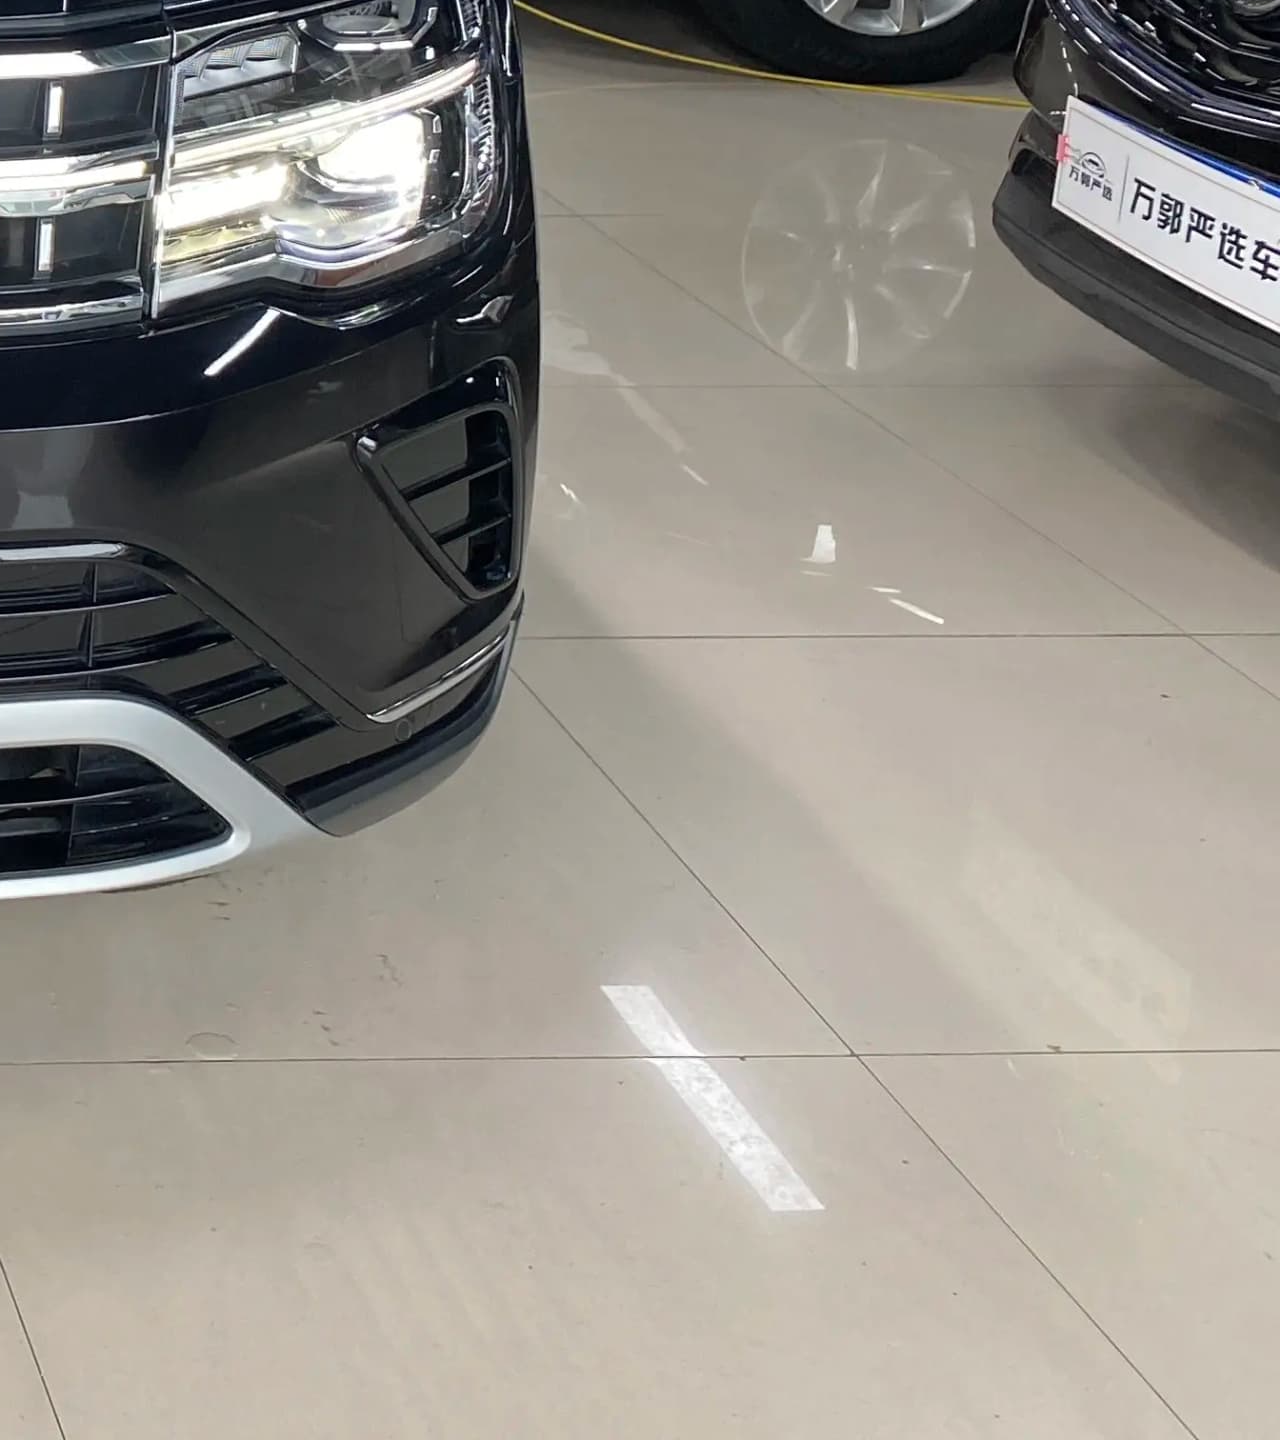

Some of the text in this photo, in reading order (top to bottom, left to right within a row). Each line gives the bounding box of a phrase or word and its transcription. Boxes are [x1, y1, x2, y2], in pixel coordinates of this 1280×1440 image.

[1069, 164, 1113, 203] 万郭严选
[1129, 176, 1280, 282] 万郭严选车
